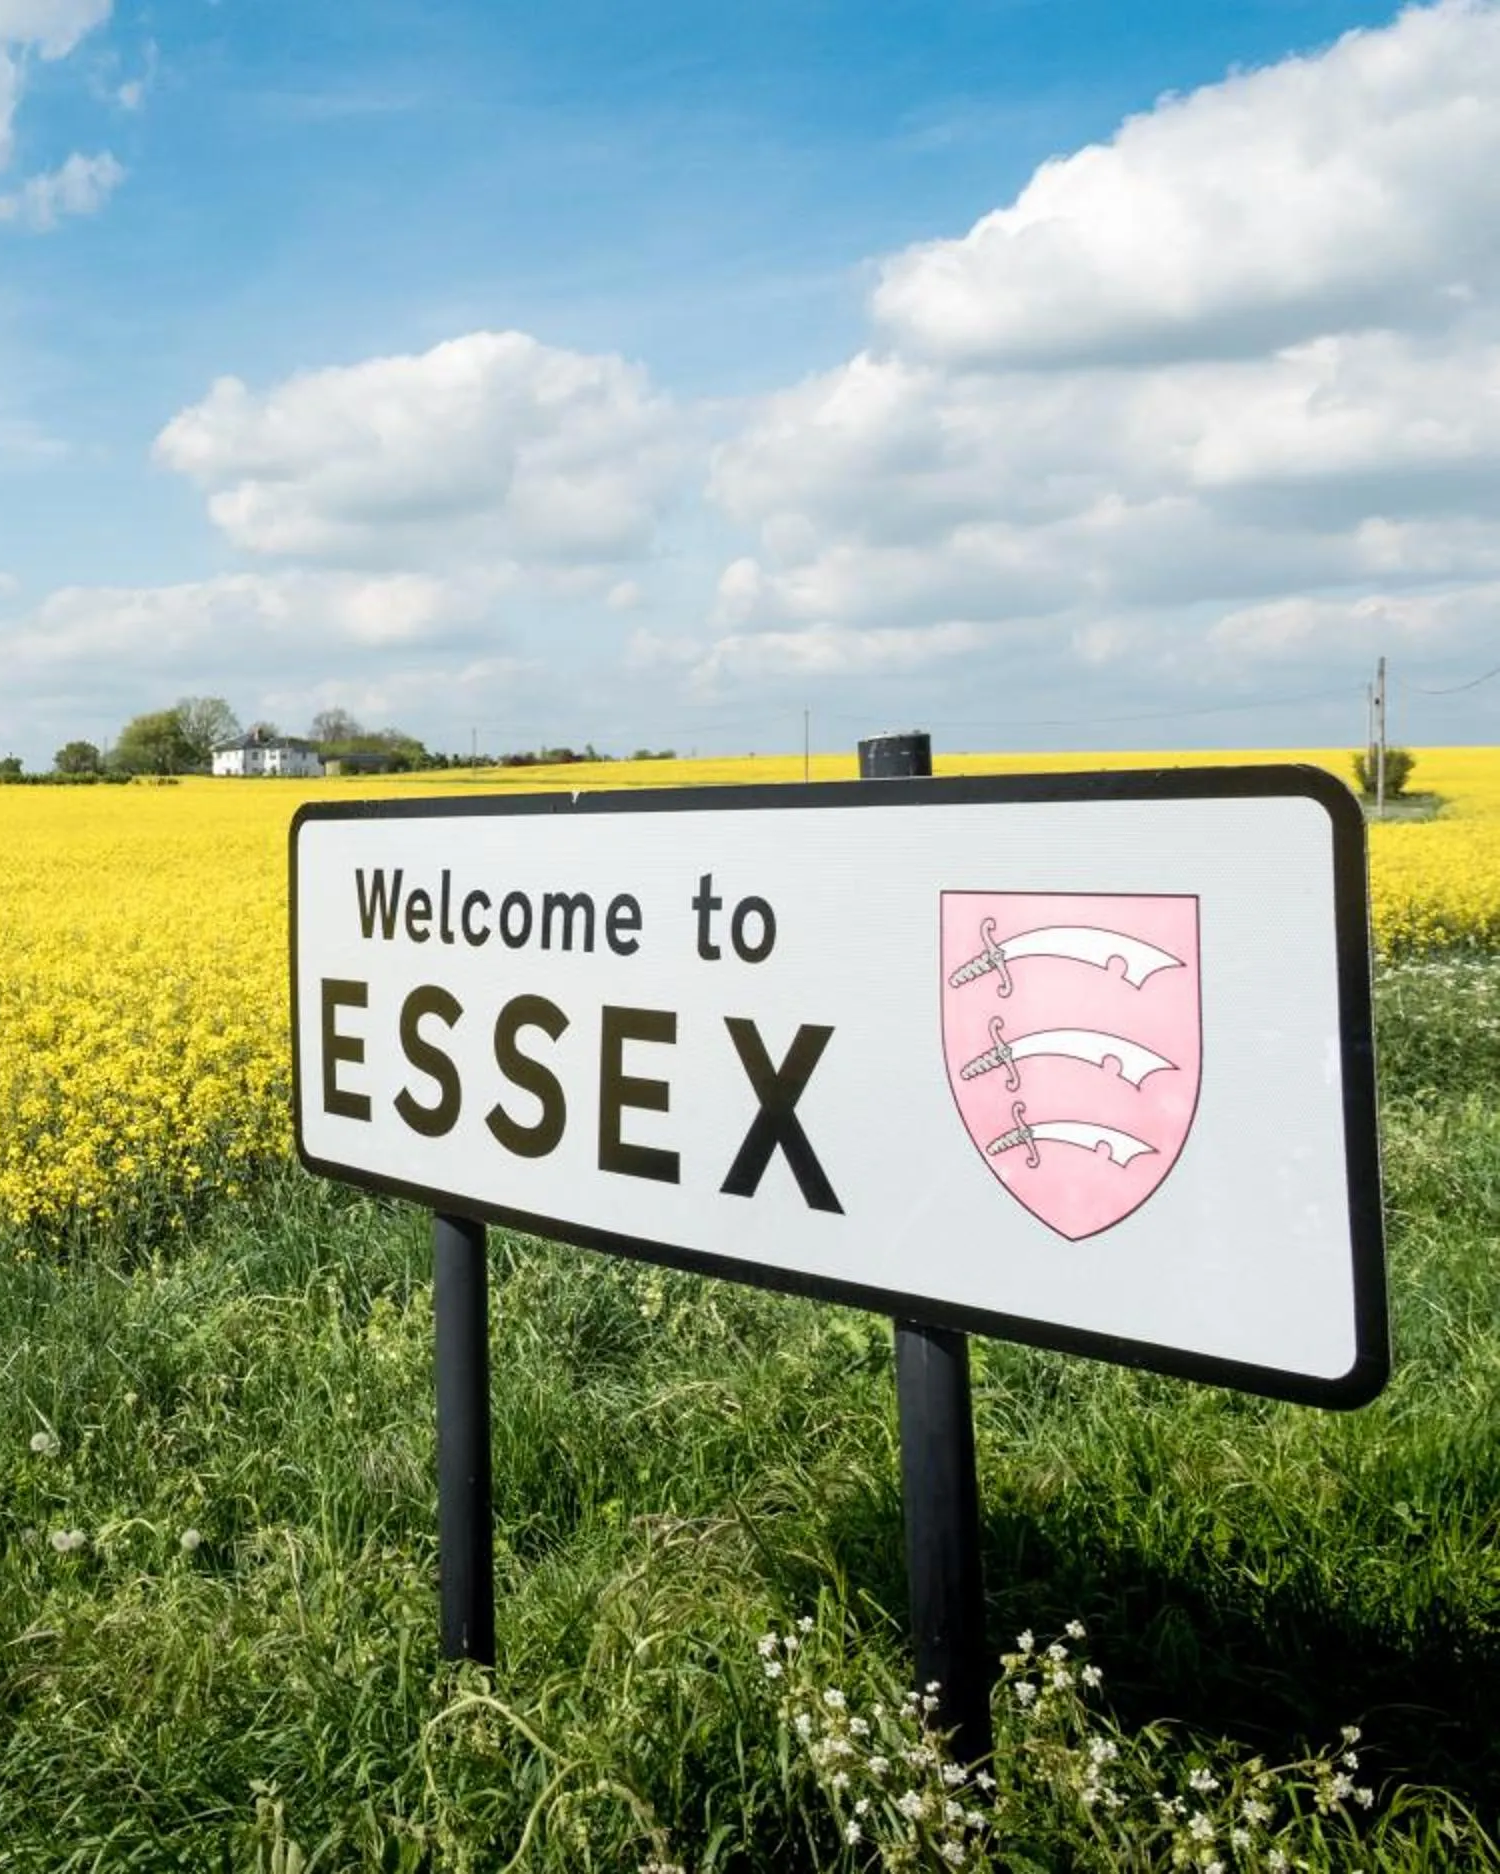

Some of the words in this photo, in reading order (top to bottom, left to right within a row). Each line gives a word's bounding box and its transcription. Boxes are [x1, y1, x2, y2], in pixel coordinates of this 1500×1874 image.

[355, 868, 643, 957] Welcome
[691, 873, 777, 964] to
[321, 977, 845, 1215] ESSEX
